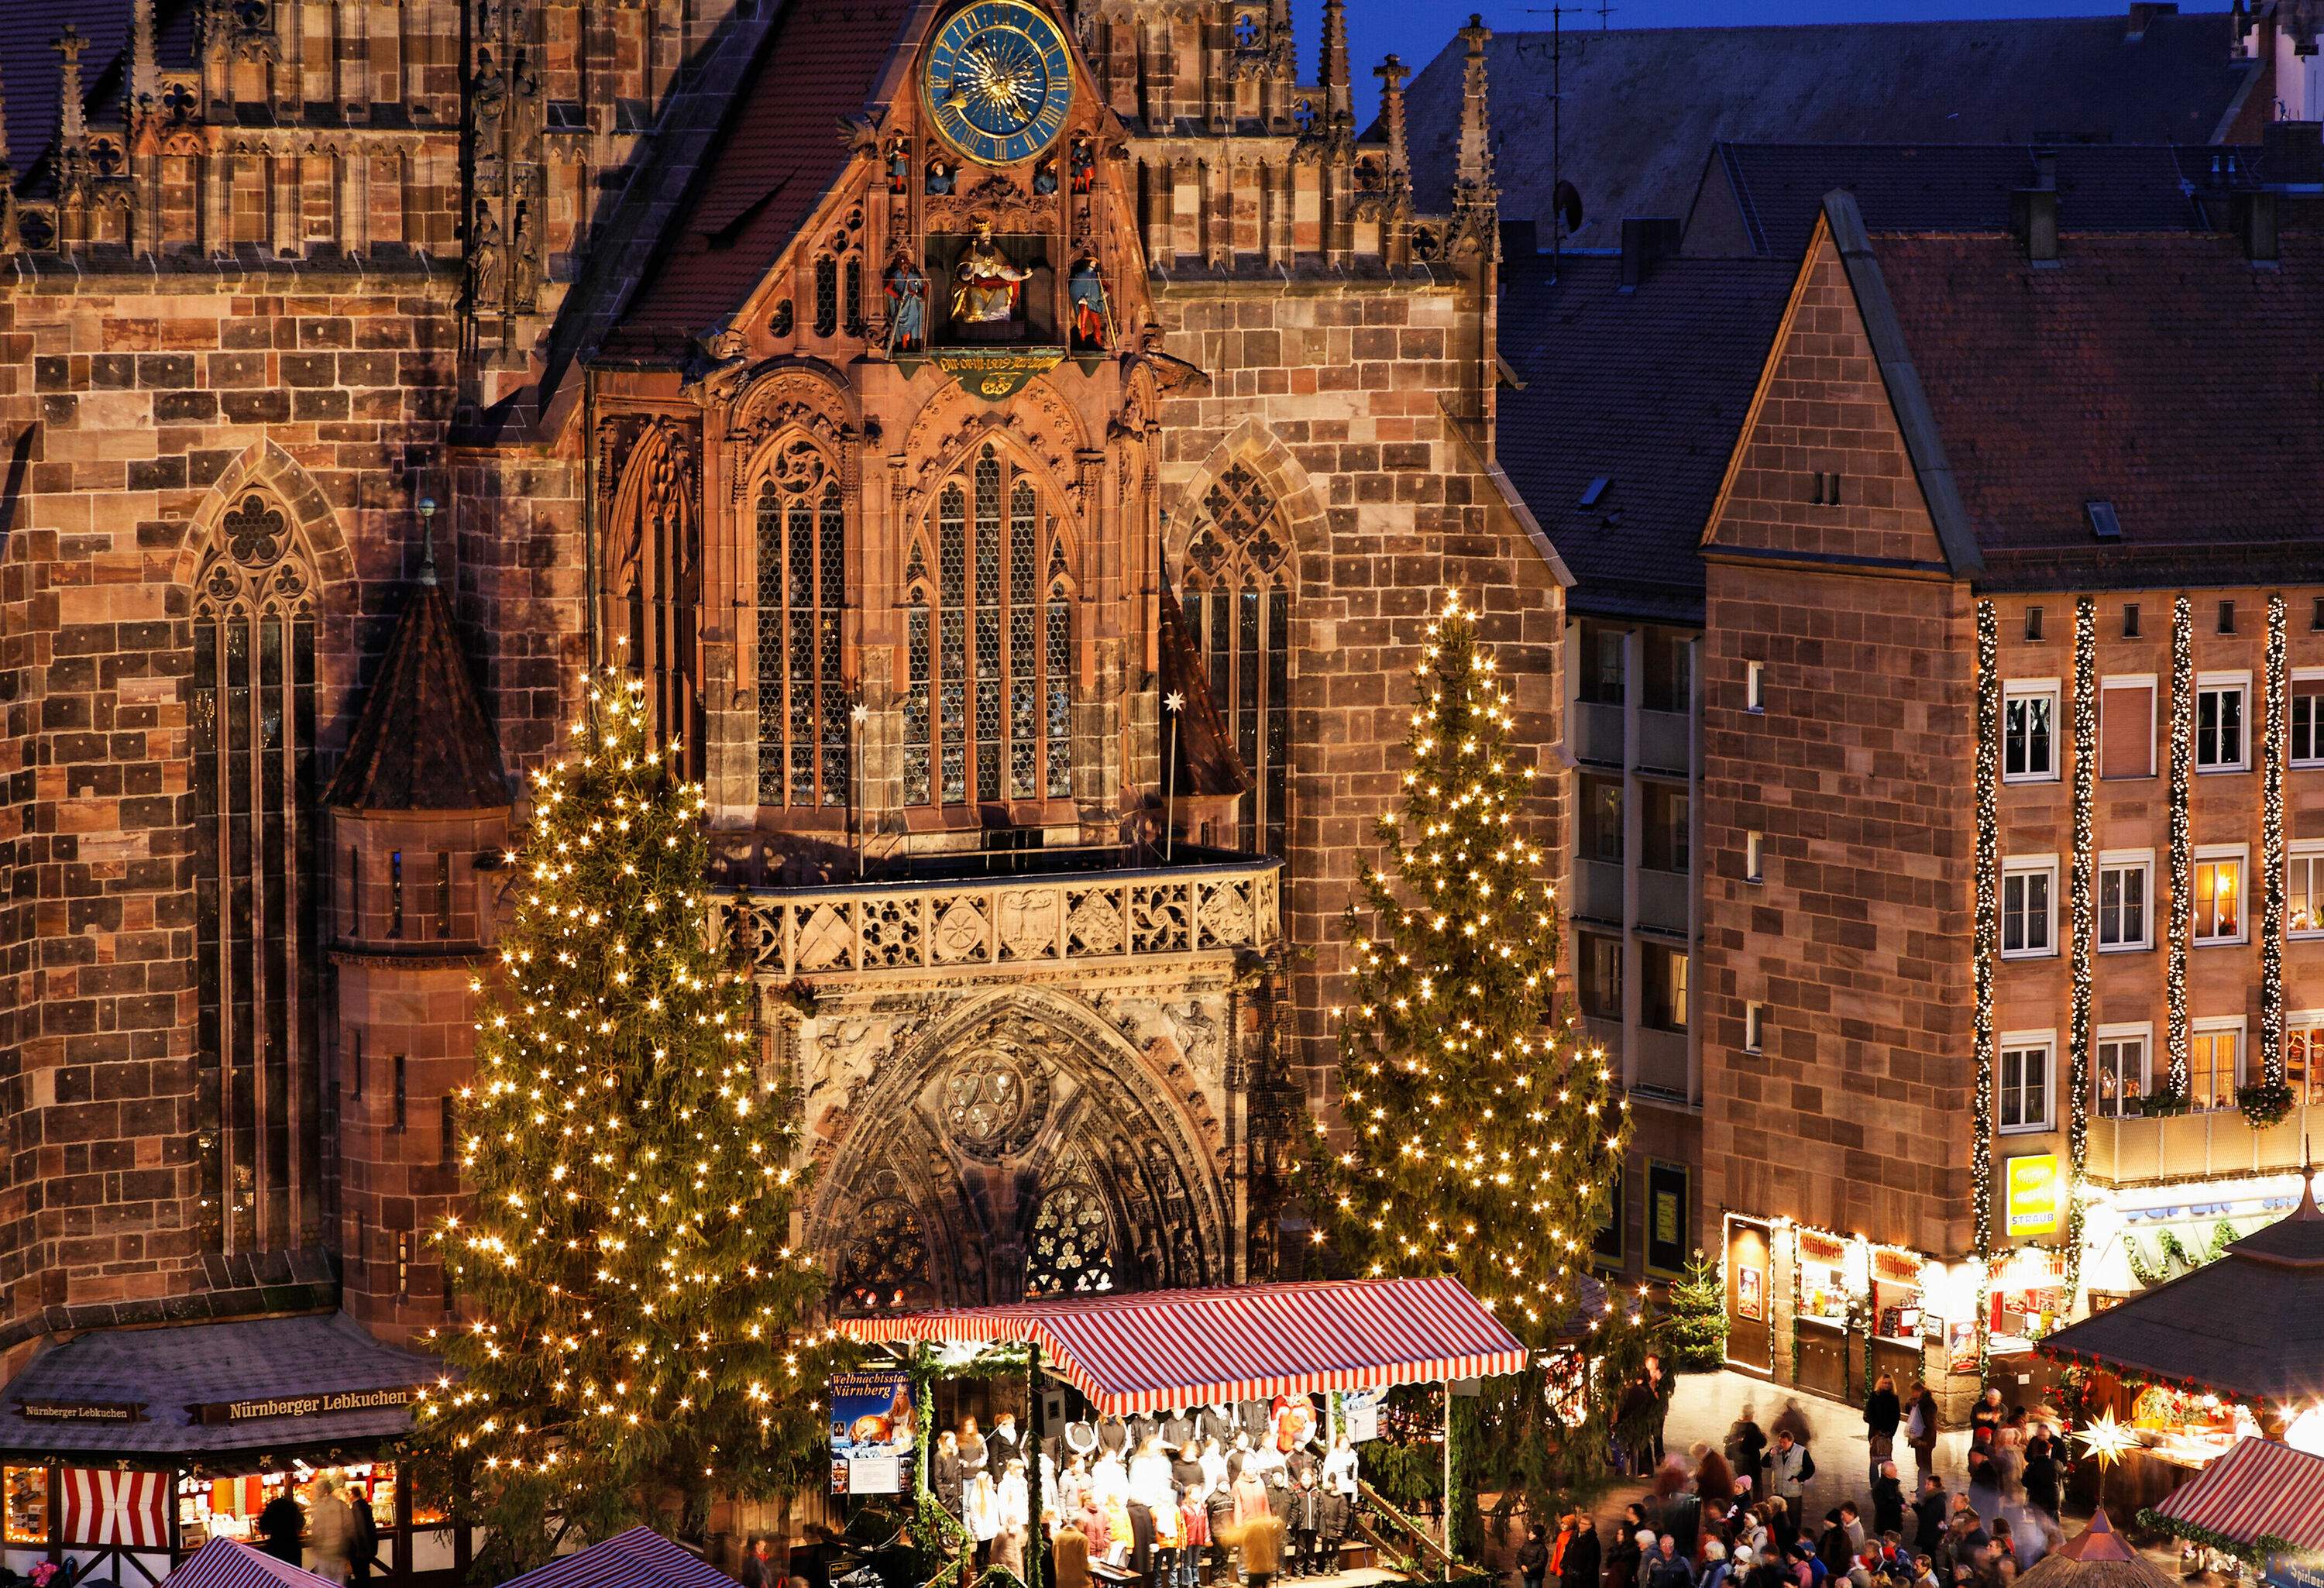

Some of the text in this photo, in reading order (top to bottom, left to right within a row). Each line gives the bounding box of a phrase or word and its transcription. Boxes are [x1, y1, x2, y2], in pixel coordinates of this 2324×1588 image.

[1050, 76, 1068, 91] III
[2012, 1213, 2054, 1225] STRAUB
[833, 1384, 892, 1399] Nürnberg
[229, 1390, 407, 1419] Nürnberger Lebkuchen
[26, 1406, 127, 1419] Nürnberger Lebkuchen
